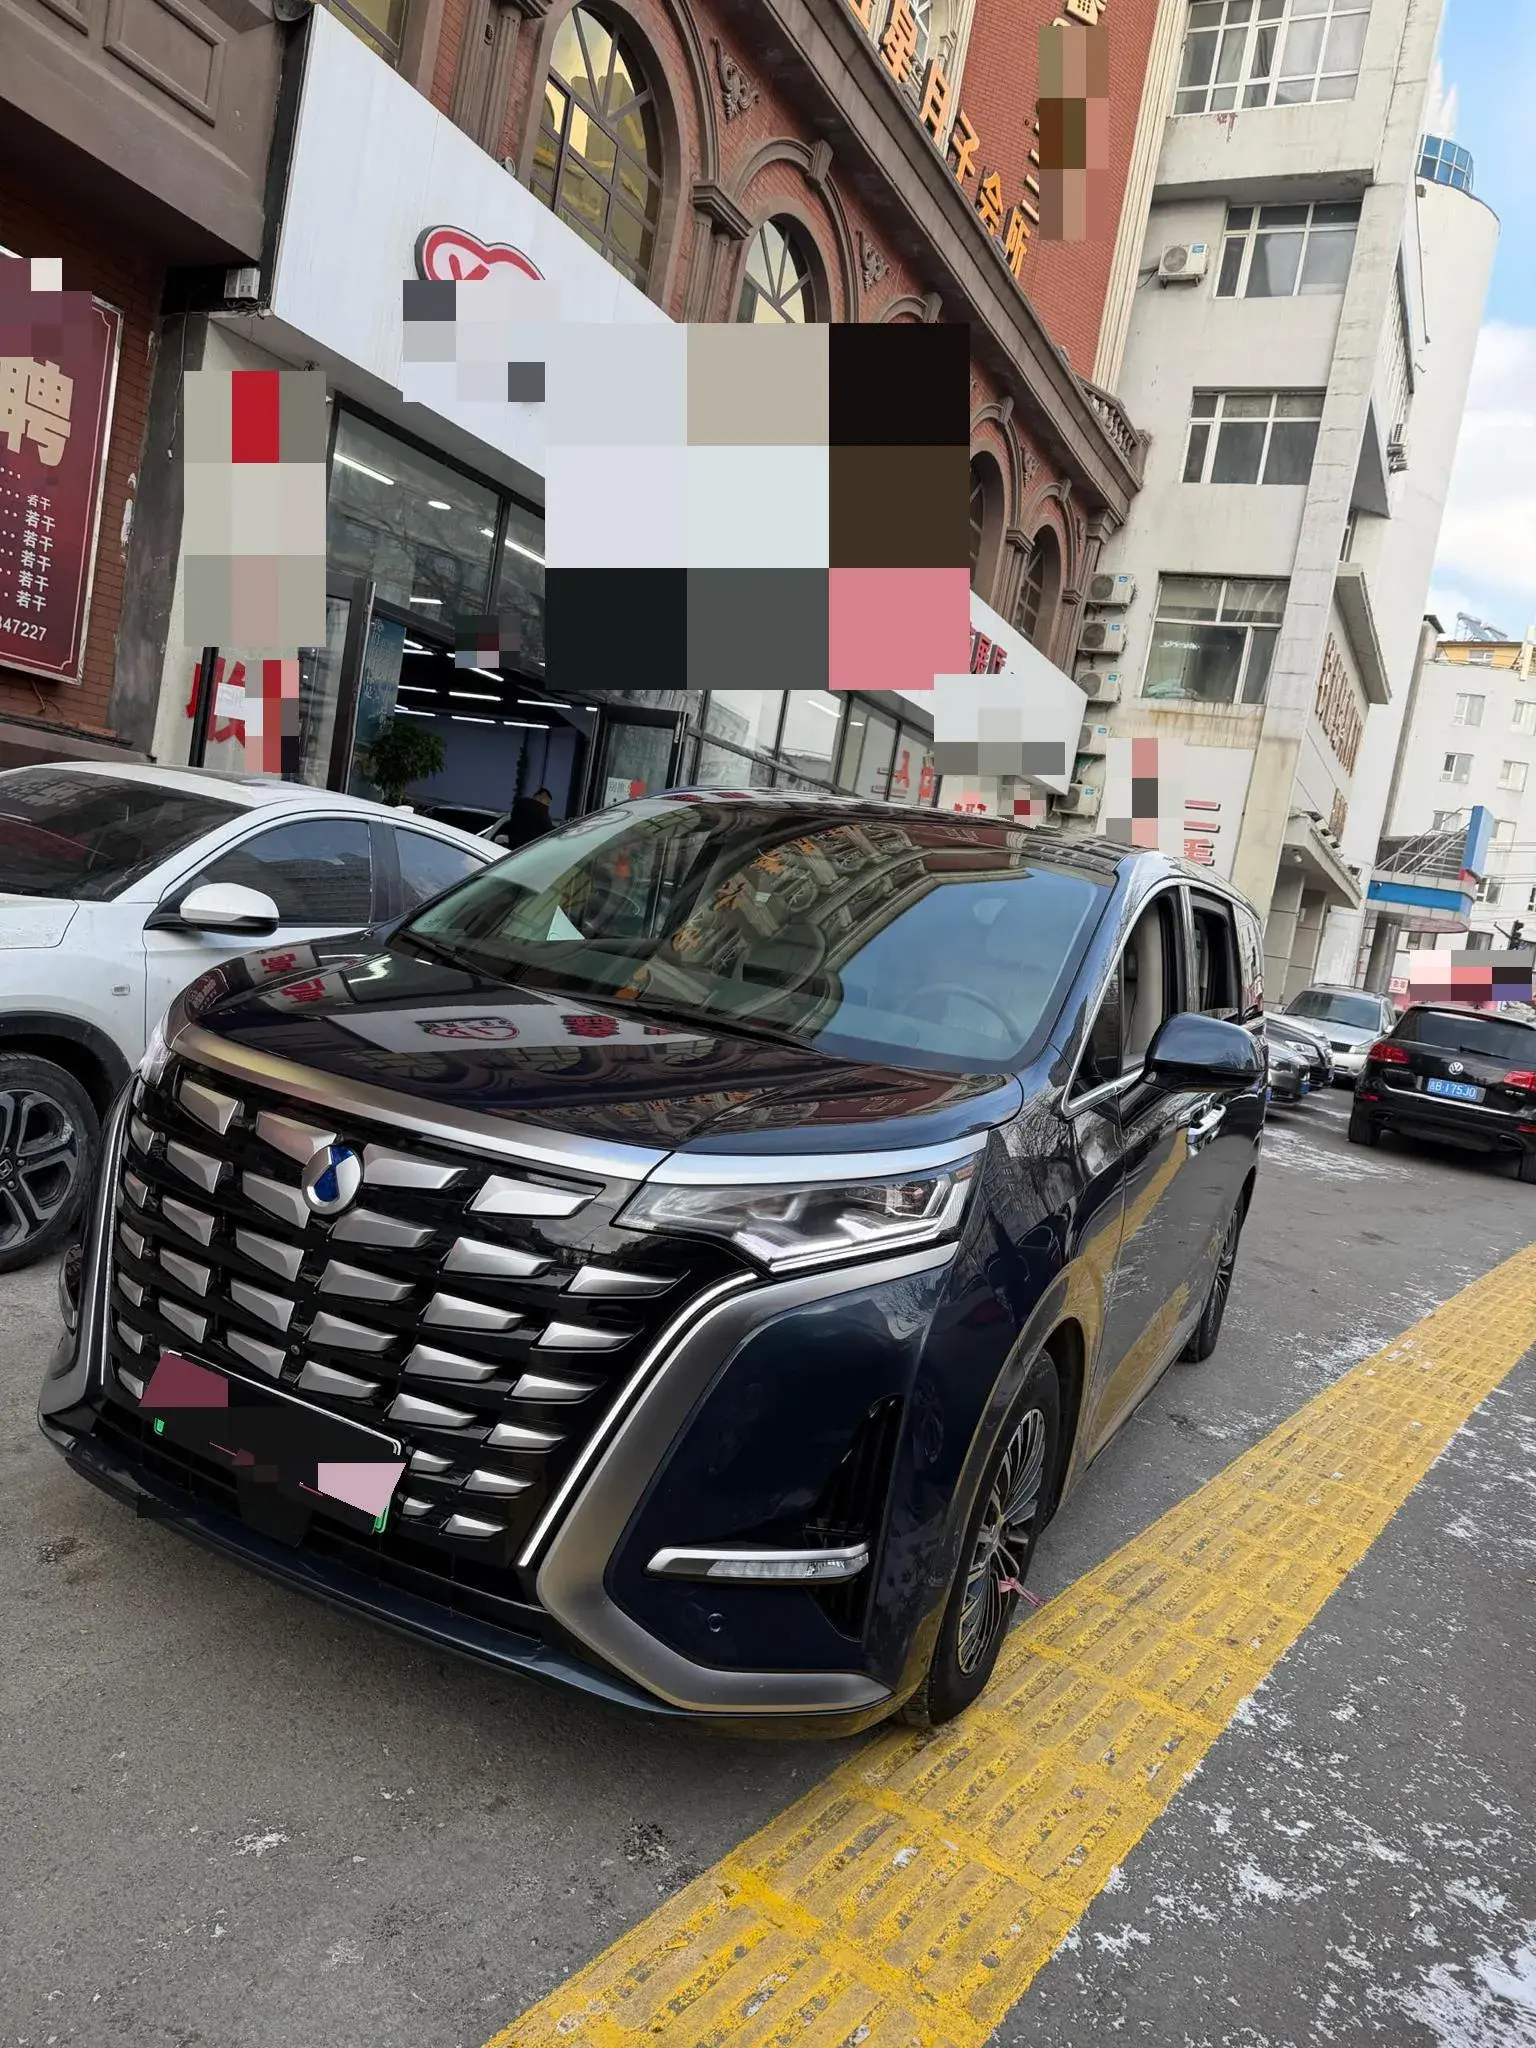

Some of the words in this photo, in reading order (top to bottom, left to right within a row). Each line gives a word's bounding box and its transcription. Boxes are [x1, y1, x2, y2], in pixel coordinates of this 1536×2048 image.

[27, 494, 51, 511] 若干
[25, 509, 56, 533] 若干
[22, 530, 54, 553] 若干
[20, 550, 51, 572] 若干
[18, 570, 49, 593] 若干
[16, 590, 47, 613] 若干
[970, 622, 1008, 675] 展厅
